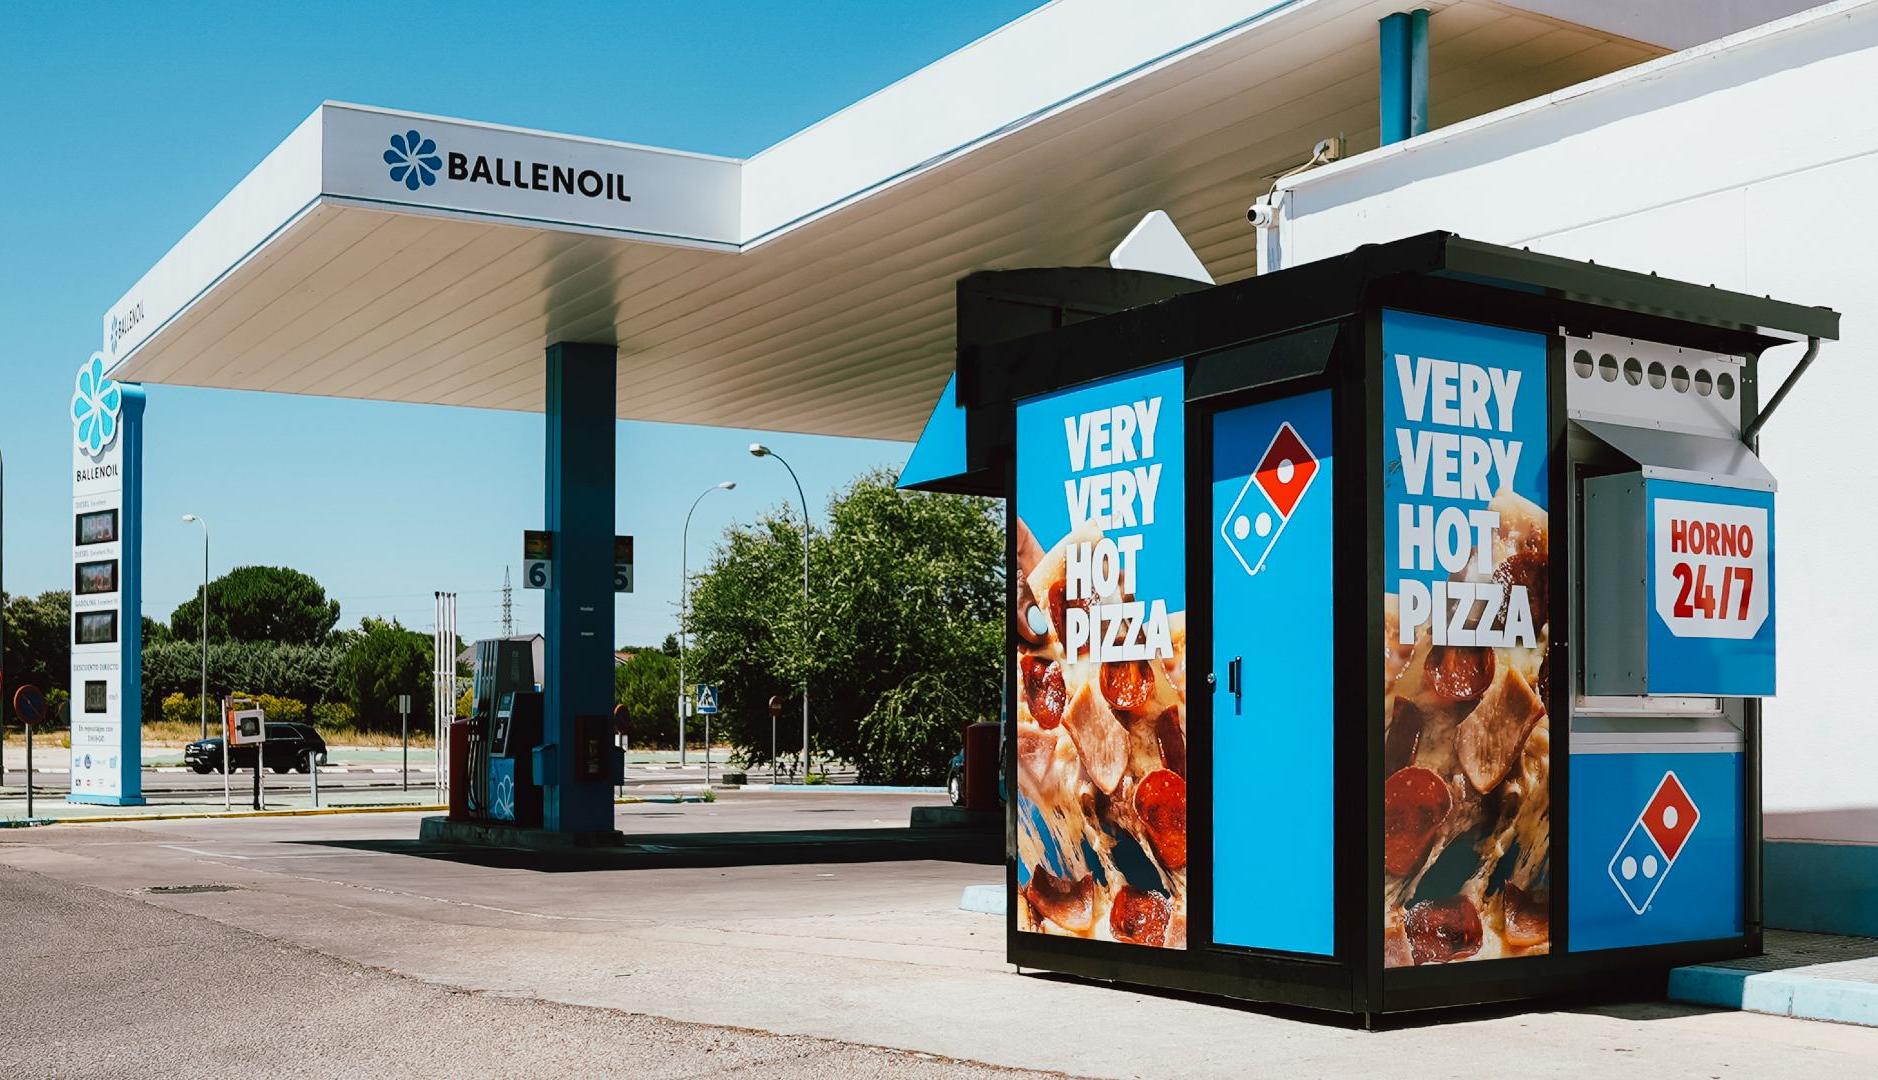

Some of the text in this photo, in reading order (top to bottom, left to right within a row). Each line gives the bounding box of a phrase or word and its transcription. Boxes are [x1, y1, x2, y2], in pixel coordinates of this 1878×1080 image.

[448, 152, 631, 202] BALLENOIL
[118, 299, 145, 340] BALLENOIL
[1394, 354, 1522, 432] VERY
[1064, 396, 1162, 472] VERY
[1395, 428, 1523, 502] VERY
[76, 463, 118, 482] BALLENOIL
[1064, 463, 1162, 533] VERY
[1066, 534, 1143, 600] HOT
[1398, 504, 1500, 574] HOT
[1671, 519, 1753, 558] HORNO
[529, 562, 546, 587] 6
[614, 566, 628, 590] 5
[1672, 562, 1753, 620] 24/7
[1066, 599, 1174, 664] PIZZA
[1399, 579, 1537, 649] PIZZA
